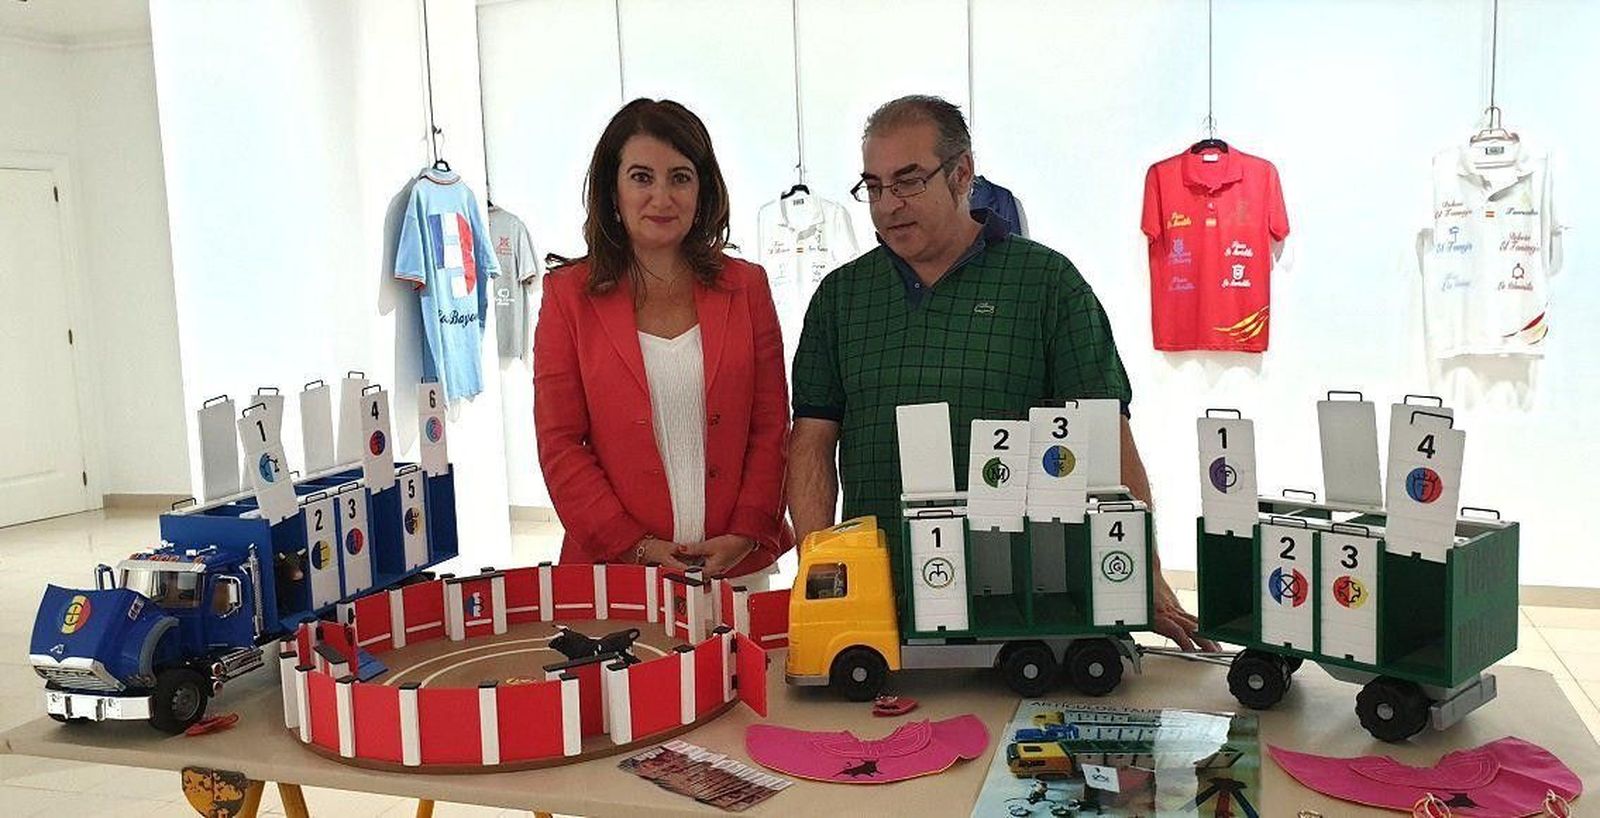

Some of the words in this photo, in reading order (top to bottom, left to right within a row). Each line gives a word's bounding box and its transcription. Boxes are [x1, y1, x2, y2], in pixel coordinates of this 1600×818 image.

[428, 389, 437, 409] 6
[370, 401, 380, 421] 4
[256, 420, 267, 443] 1
[1051, 416, 1069, 439] 3
[1217, 426, 1228, 449] 1
[992, 428, 1010, 450] 2
[1416, 433, 1436, 459] 4
[407, 479, 416, 499] 5
[348, 498, 357, 519] 3
[314, 509, 324, 532] 2
[1108, 520, 1125, 542] 4
[930, 527, 943, 548] 1
[1279, 536, 1296, 561] 2
[1340, 544, 1359, 569] 3
